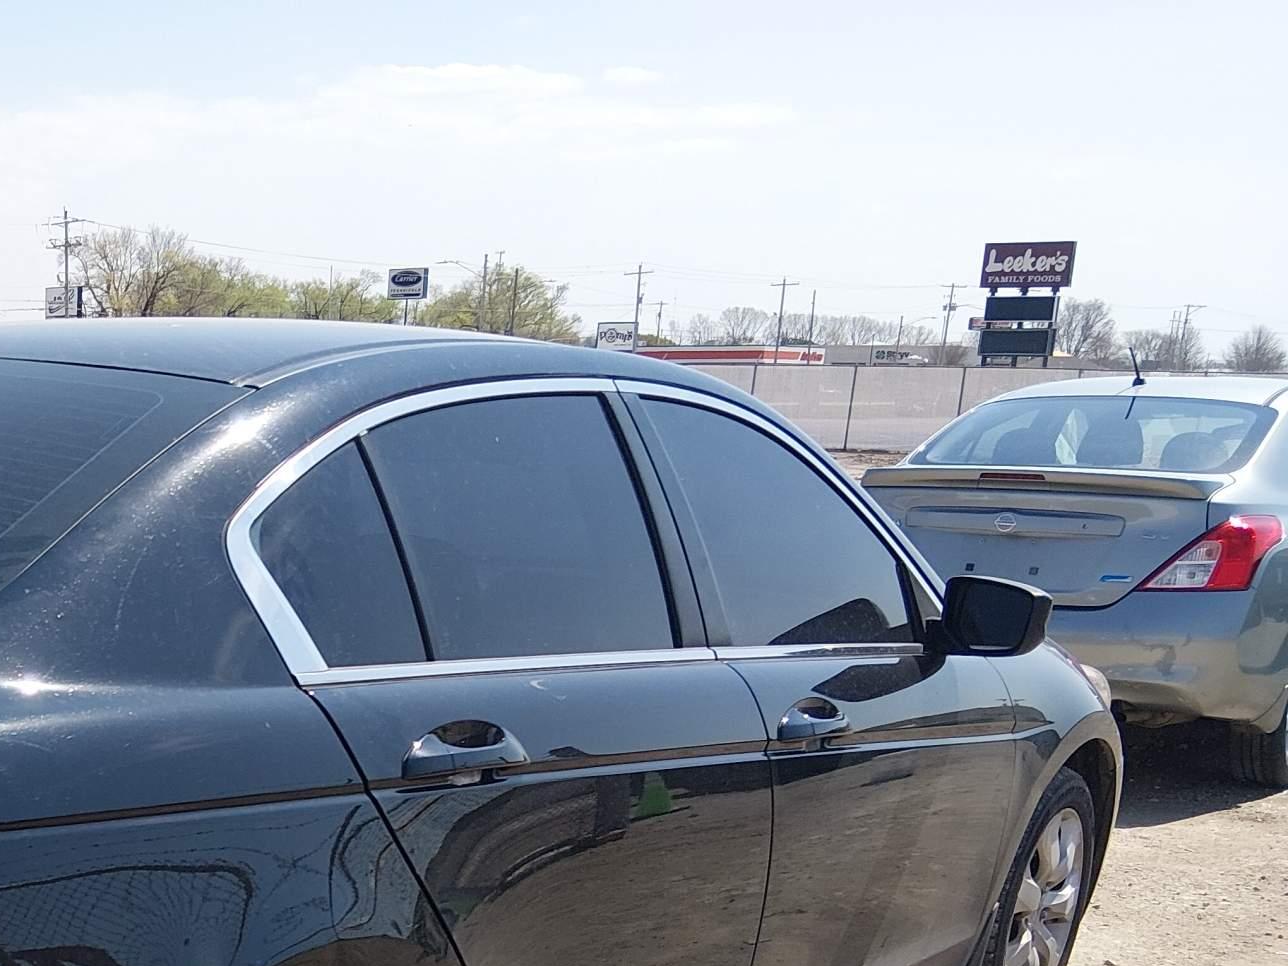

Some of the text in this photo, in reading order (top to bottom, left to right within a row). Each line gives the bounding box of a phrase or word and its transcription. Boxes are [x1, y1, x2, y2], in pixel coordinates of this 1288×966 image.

[985, 248, 1069, 273] Leeker's
[987, 275, 1062, 284] FAMILY FOODS
